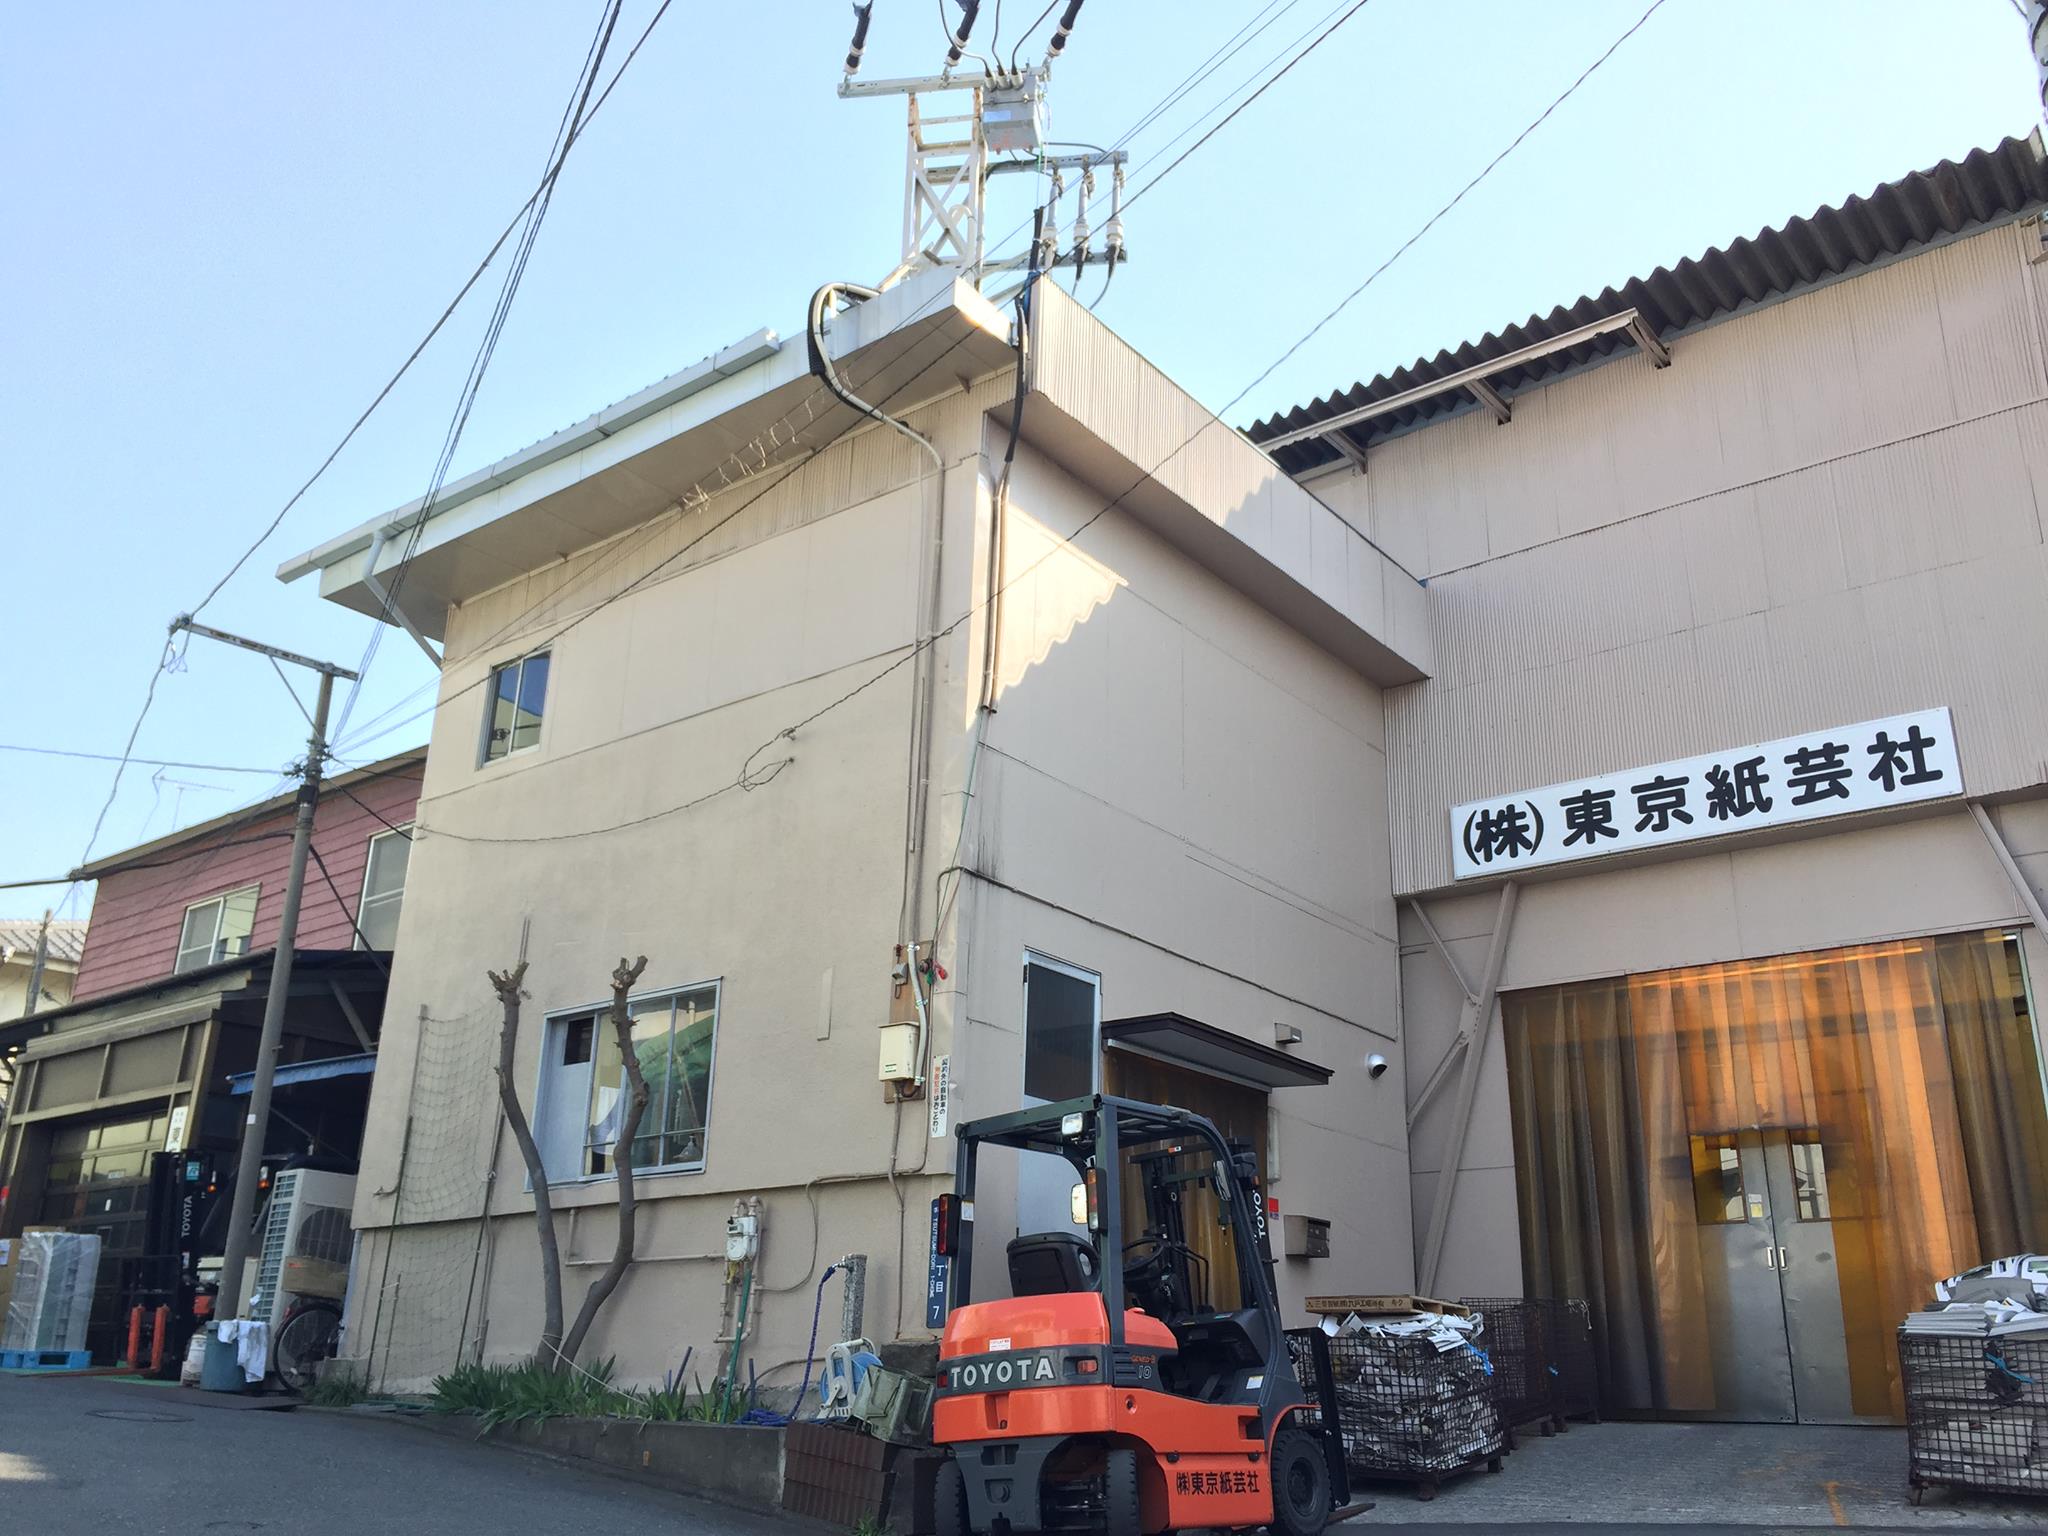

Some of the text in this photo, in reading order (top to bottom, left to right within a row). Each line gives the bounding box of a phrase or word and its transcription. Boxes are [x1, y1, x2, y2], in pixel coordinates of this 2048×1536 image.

[1464, 725, 1943, 866] (株)東京紙芸社
[181, 1195, 193, 1238] TOYOTA
[1253, 1189, 1266, 1239] TOYO
[951, 1357, 1054, 1388] TOYOTA
[1176, 1470, 1260, 1496] (株)東京紙芸社
